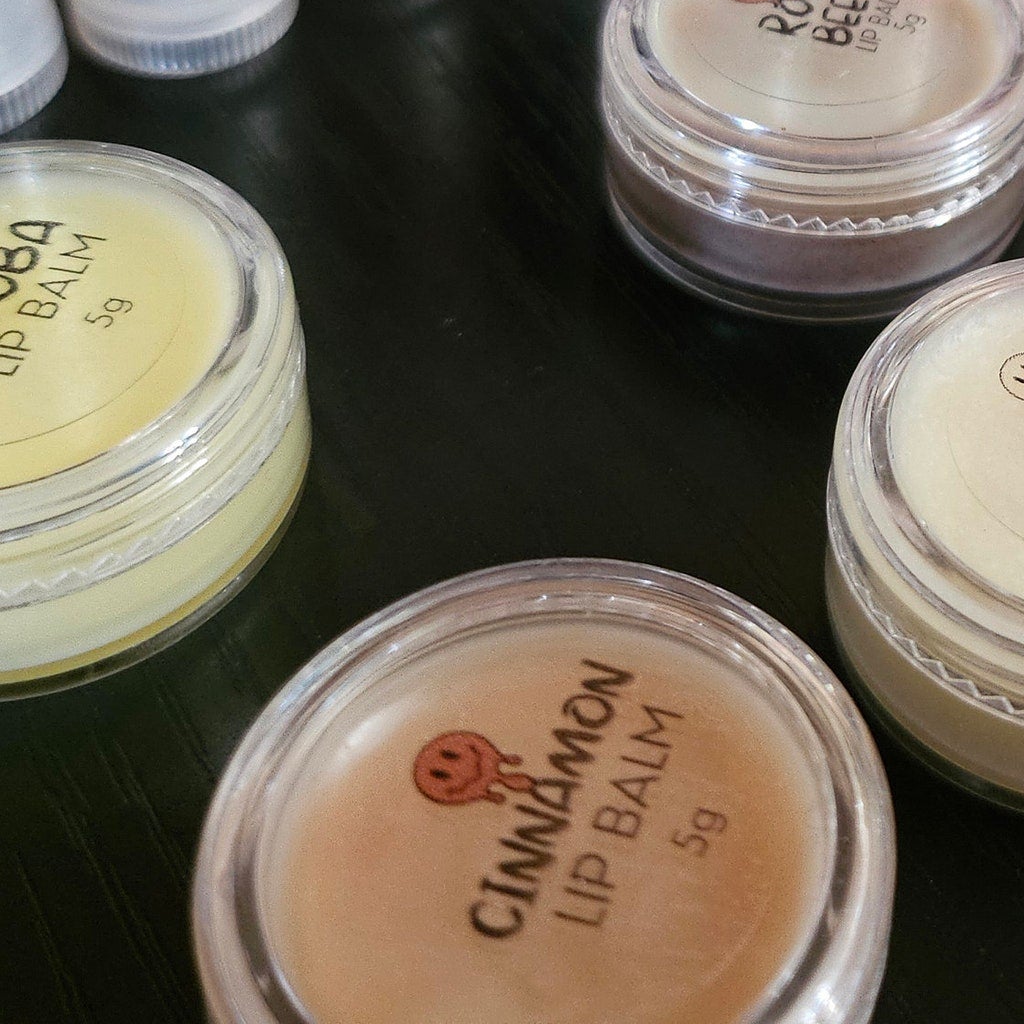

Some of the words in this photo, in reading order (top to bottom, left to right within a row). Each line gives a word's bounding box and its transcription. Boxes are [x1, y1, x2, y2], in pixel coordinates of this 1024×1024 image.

[855, 28, 881, 53] LIP
[893, 13, 927, 35] 5g
[17, 232, 107, 320] BALM
[84, 298, 133, 328] 5g
[467, 658, 635, 940] CINNAMON
[554, 852, 616, 927] LIP
[591, 704, 684, 839] BALM
[671, 808, 728, 856] 5g
